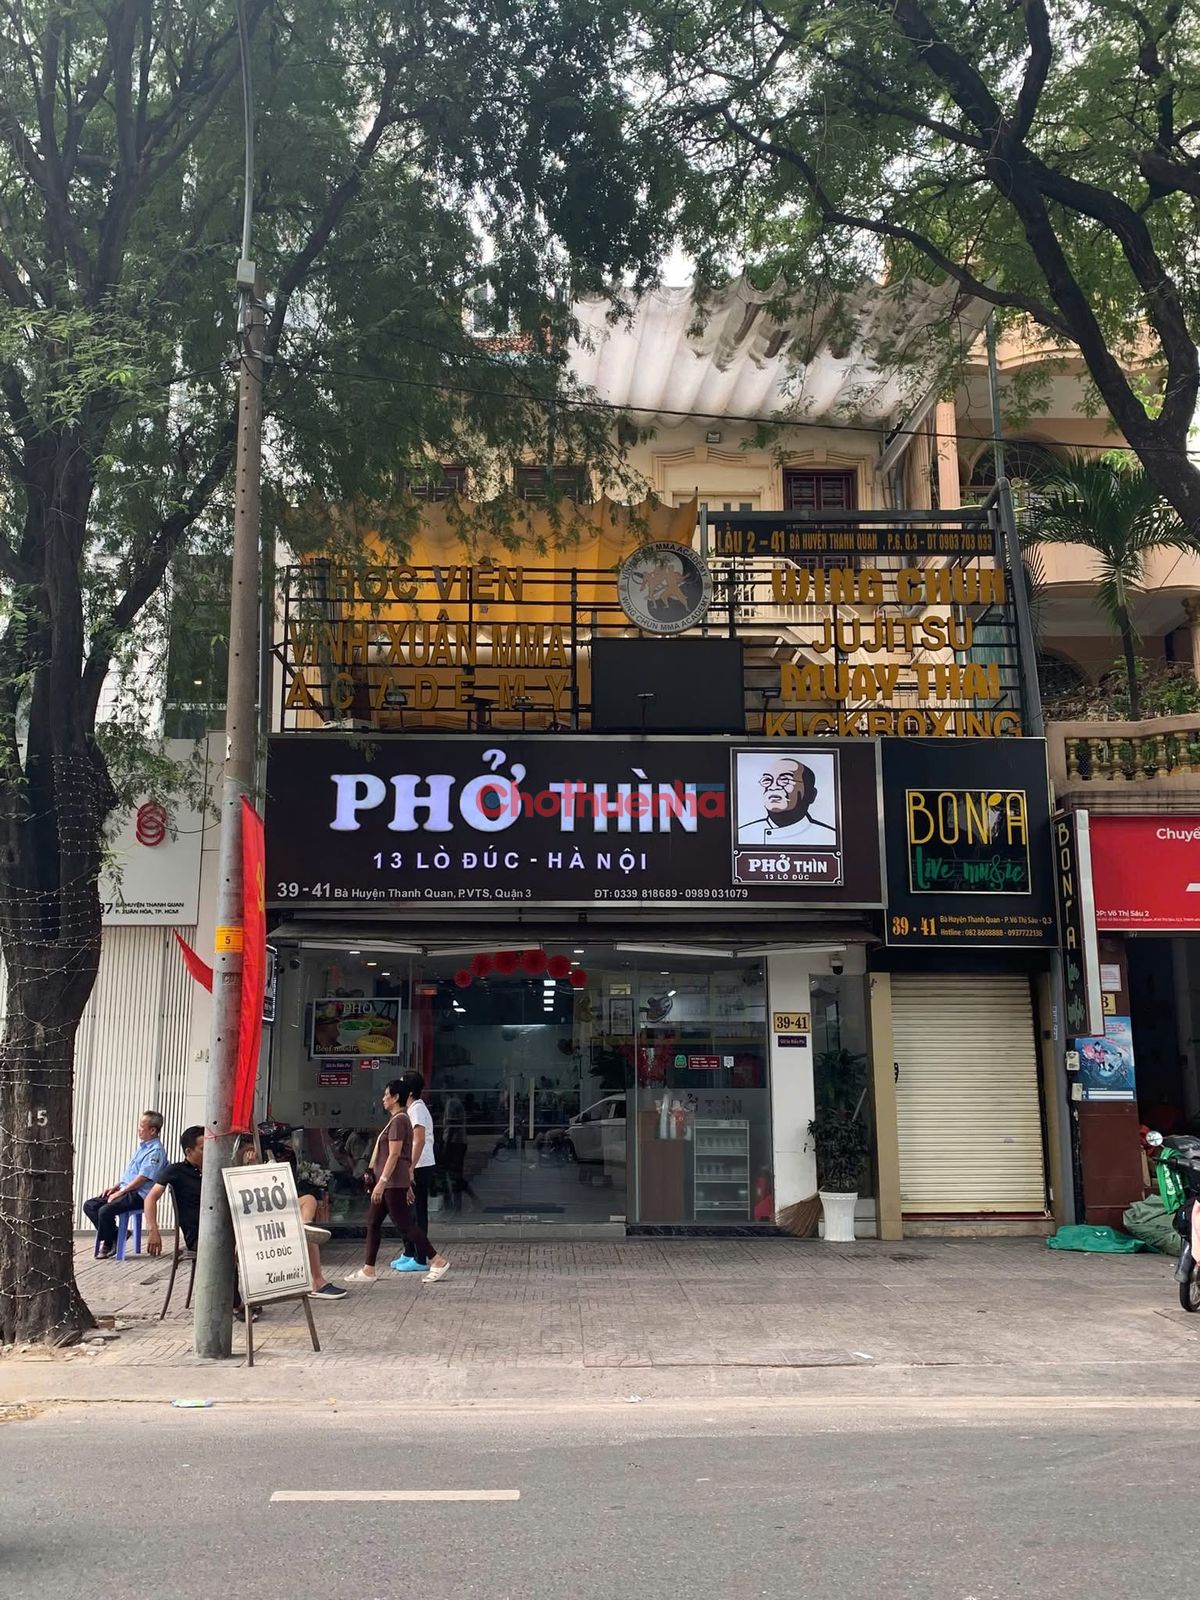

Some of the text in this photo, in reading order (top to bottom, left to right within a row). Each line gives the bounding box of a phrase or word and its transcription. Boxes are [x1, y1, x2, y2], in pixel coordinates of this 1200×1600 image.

[717, 522, 742, 552] LẦU
[747, 531, 756, 553] 2
[771, 531, 785, 552] 41
[830, 533, 854, 550] THANH
[857, 533, 877, 550] QUAN
[940, 533, 959, 550] 0903
[961, 533, 975, 550] 703
[978, 533, 993, 550] 033
[677, 546, 708, 577] ACADEMY
[771, 568, 1006, 605] WING CHUN
[622, 595, 710, 631] WING CHUN MMA ACADEMY
[386, 609, 477, 667] XUÂN
[491, 623, 568, 668] MMA
[812, 616, 973, 653] JUJITSU
[286, 671, 569, 711] ACADEMY
[780, 663, 999, 700] MUAY THAI
[766, 709, 1022, 737] KICKBOXING
[329, 748, 699, 833] PHỞ THÌN
[373, 852, 402, 869] 13
[416, 844, 450, 869] LÒ
[462, 844, 519, 869] ĐÚC
[548, 846, 585, 870] HÀ
[597, 847, 646, 874] NỘI
[748, 854, 828, 873] PHỞ THÌN
[277, 882, 299, 898] 39
[311, 882, 331, 898] 41
[334, 888, 348, 898] Bà
[351, 888, 385, 900] Huyện
[388, 888, 420, 899] Thanh
[424, 888, 456, 899] Quan,
[495, 888, 523, 900] Quận
[525, 889, 532, 898] 3
[765, 873, 774, 881] 13
[614, 889, 638, 898] 0339
[641, 889, 678, 898] 818689
[685, 889, 710, 898] 0989
[711, 889, 748, 898] 031079
[892, 916, 909, 936] 39
[920, 916, 937, 936] 41
[967, 915, 985, 924] Thanh
[985, 916, 1000, 925] Quan
[1119, 910, 1129, 918] Thị
[225, 935, 231, 945] 5
[776, 1016, 808, 1030] 39-41
[27, 1110, 48, 1127] 15
[238, 1175, 288, 1215] PHỞ
[255, 1219, 286, 1242] THÌN
[256, 1251, 264, 1260] 13
